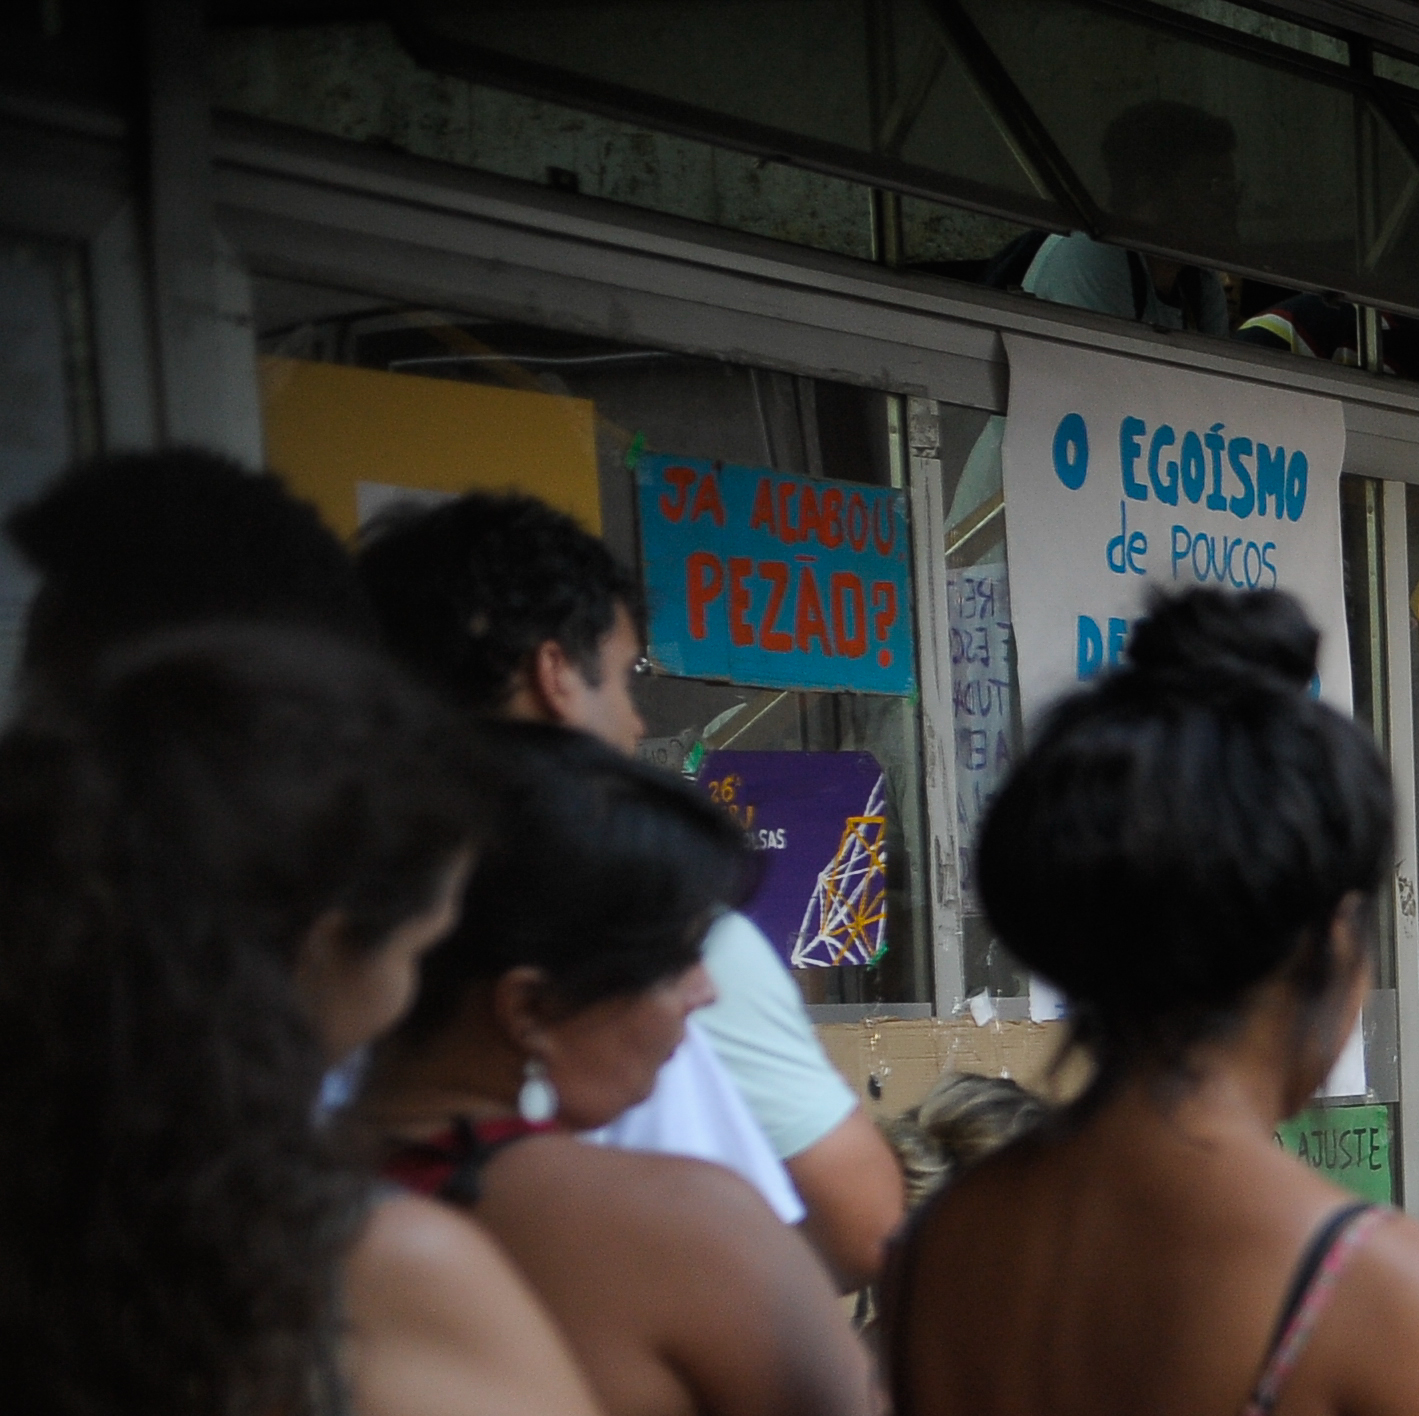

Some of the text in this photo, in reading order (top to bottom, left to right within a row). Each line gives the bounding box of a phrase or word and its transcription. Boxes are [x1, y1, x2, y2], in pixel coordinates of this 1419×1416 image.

[1052, 412, 1309, 522] O EGOÍSMO
[1106, 500, 1277, 590] de POUCOS
[1298, 1126, 1382, 1171] AJUSTE
